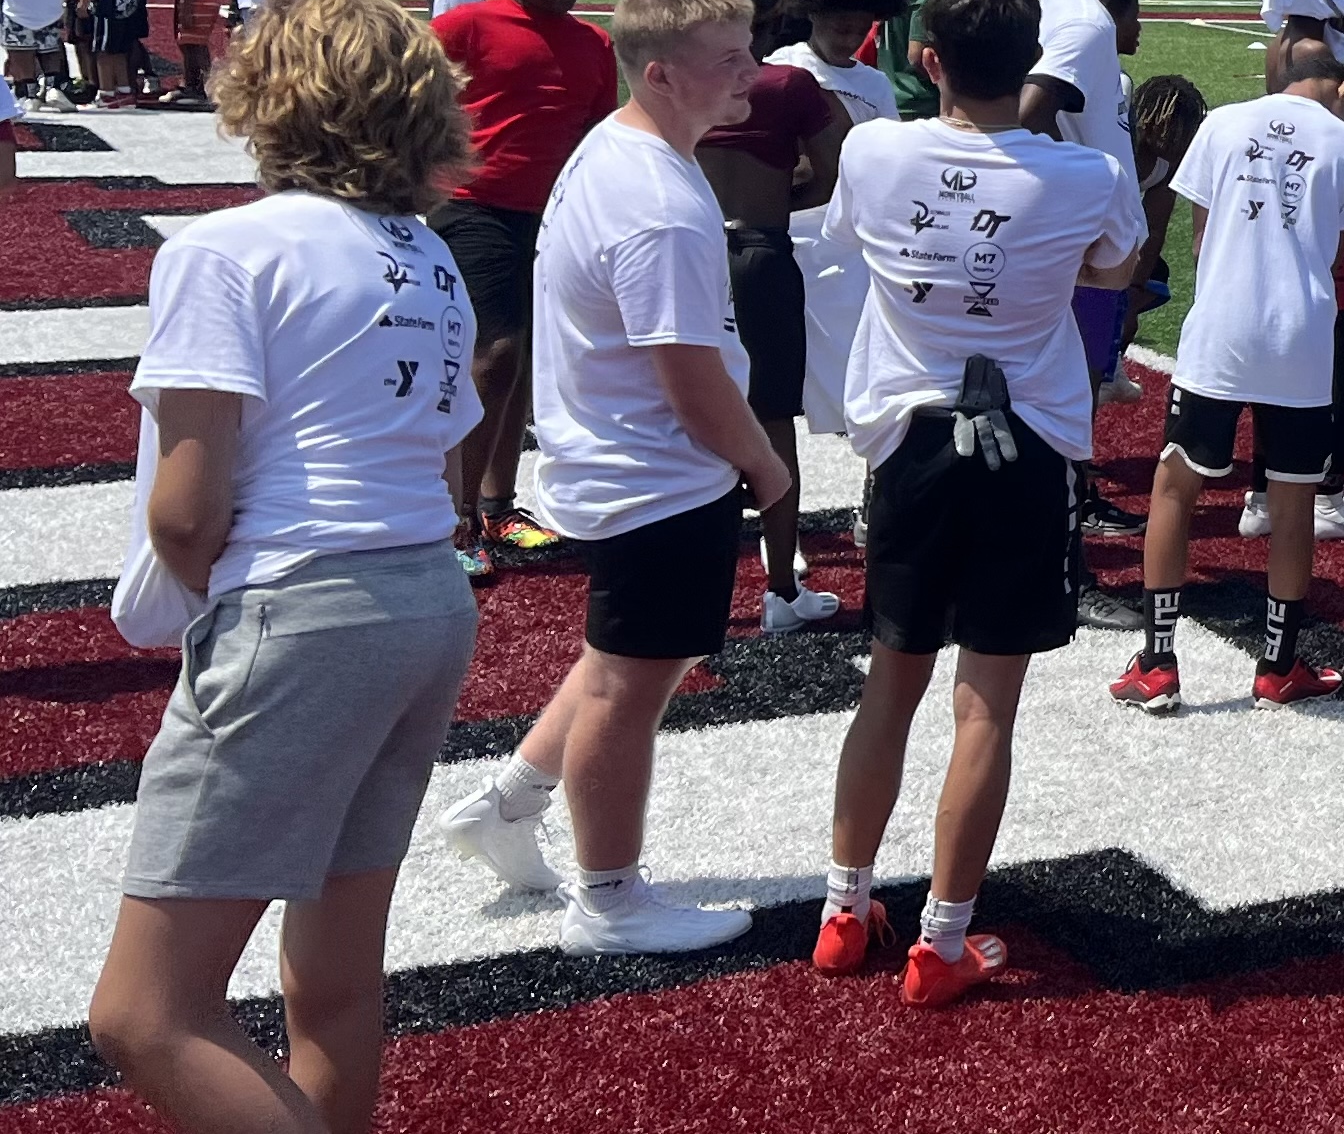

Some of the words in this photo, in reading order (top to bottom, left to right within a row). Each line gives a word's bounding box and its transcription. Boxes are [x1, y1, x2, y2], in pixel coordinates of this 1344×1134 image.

[1285, 150, 1315, 171] DT
[1285, 181, 1301, 192] M7
[970, 209, 1011, 239] DT
[911, 250, 932, 261] State
[933, 252, 957, 262] Farm
[974, 252, 996, 264] M7
[394, 315, 418, 328] State
[418, 317, 435, 331] Farm
[1154, 591, 1181, 654] ELITE
